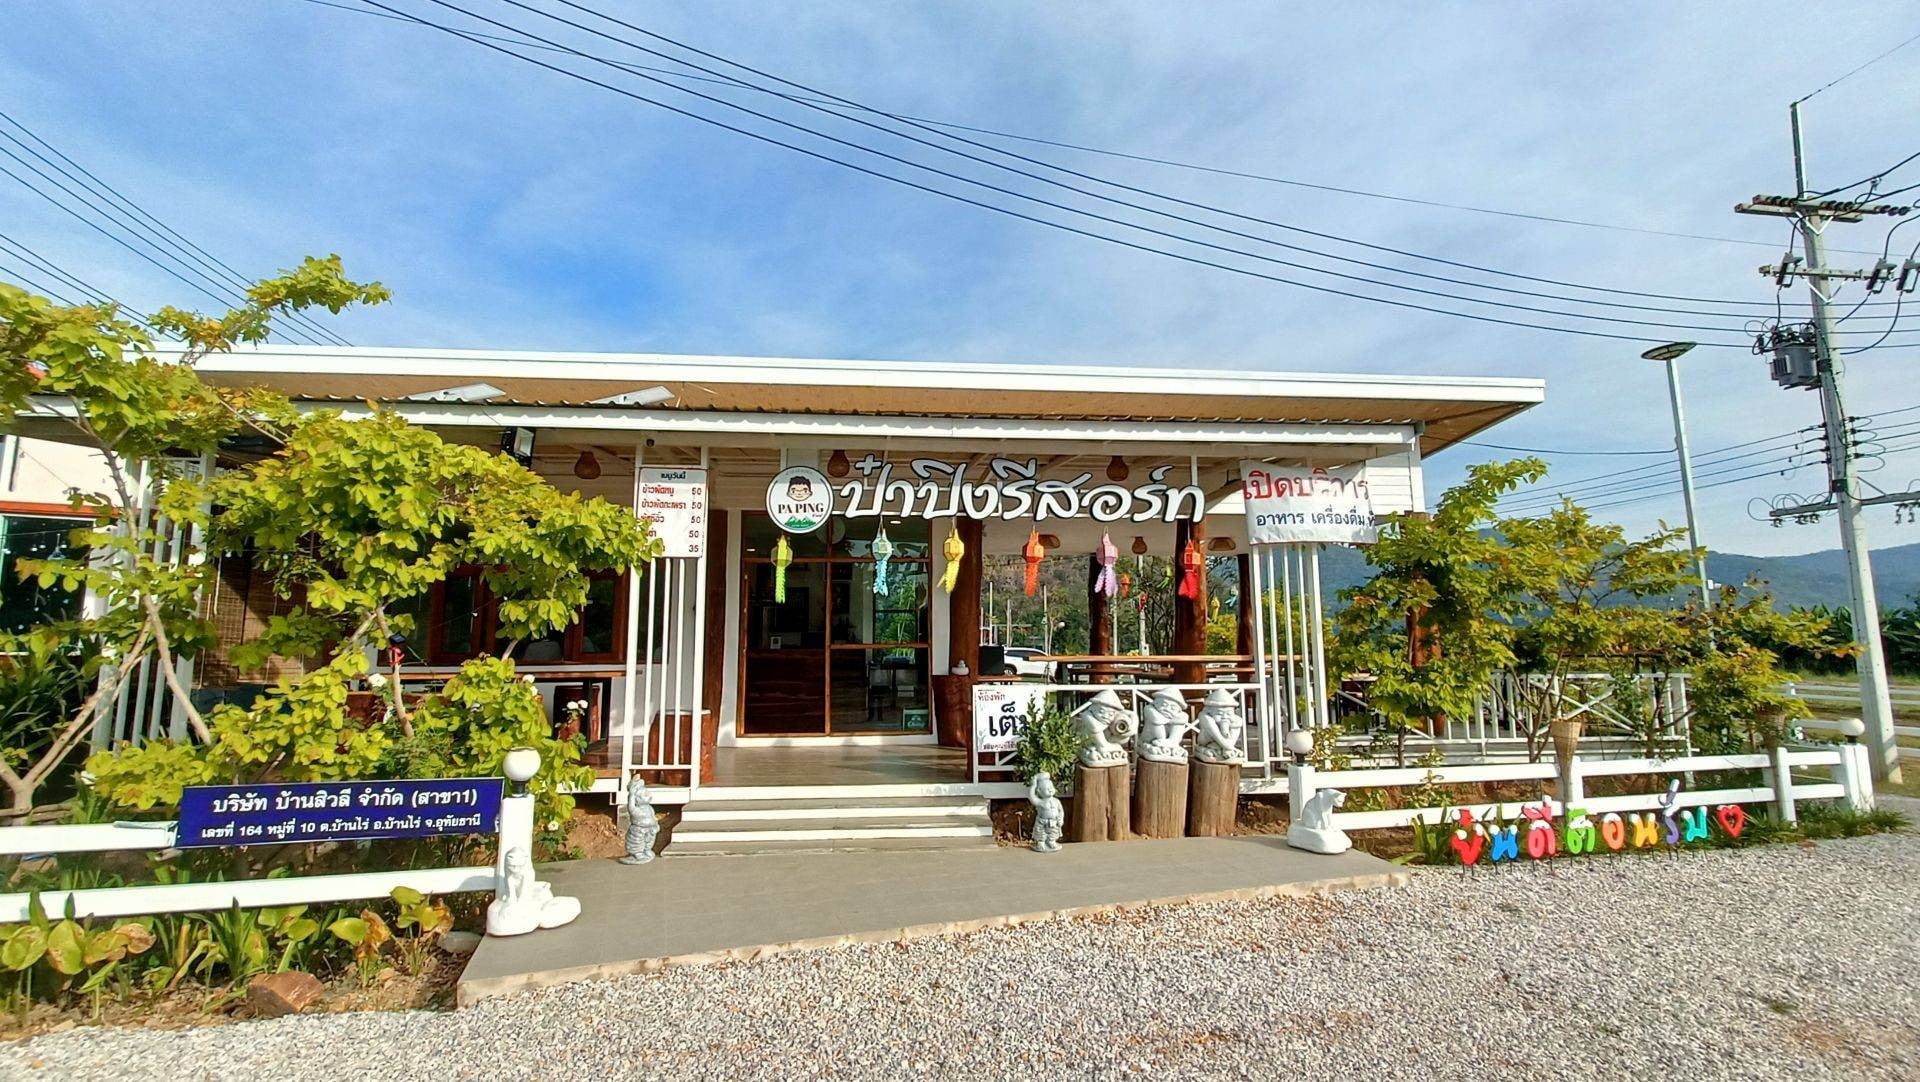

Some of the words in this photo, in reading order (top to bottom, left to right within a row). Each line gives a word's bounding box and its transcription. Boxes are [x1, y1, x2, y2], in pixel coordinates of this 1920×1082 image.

[691, 487, 702, 495] 50
[839, 453, 1205, 523] ป๋าปิงรีสอร์ท
[691, 501, 702, 510] 50
[777, 503, 793, 514] PA
[795, 502, 824, 514] PING
[690, 515, 701, 524] 50
[1256, 512, 1305, 527] อาหาร
[1311, 504, 1365, 527] เครื่องดื่ม
[688, 530, 699, 539] 50
[688, 544, 699, 553] 35
[213, 792, 268, 814] บริษัท
[358, 787, 404, 808] จำกัด
[411, 788, 478, 807] (สาขา1)
[202, 819, 235, 839] เลขที่
[239, 825, 263, 837] 164
[267, 817, 296, 840] หมู่ที่
[300, 822, 316, 833] 10
[320, 815, 369, 833] ต.บ้านไร่
[373, 814, 421, 831] อ.บ้านไร่
[424, 813, 481, 832] จ.อุทัยธานี
